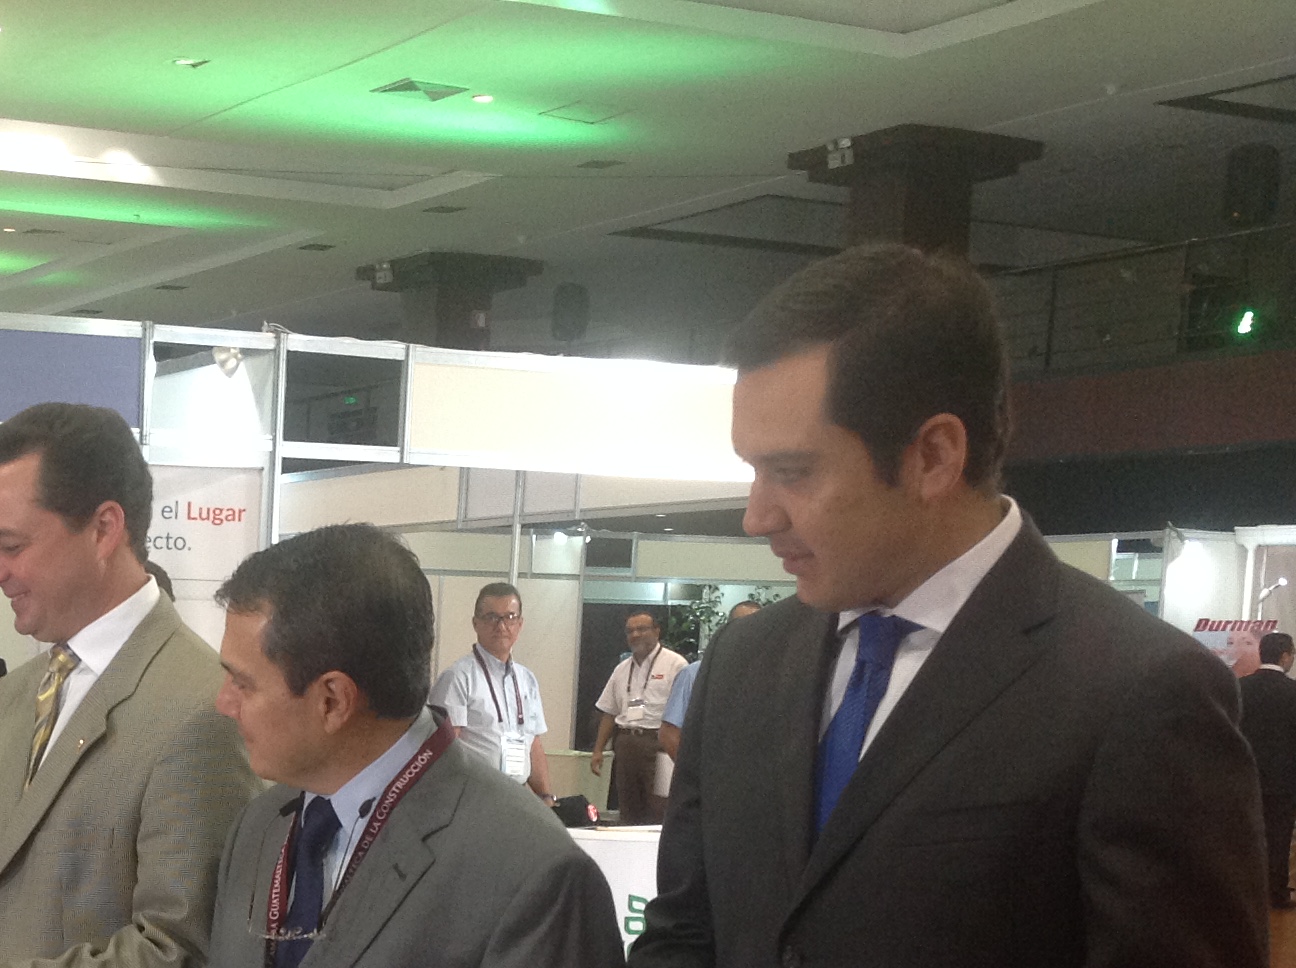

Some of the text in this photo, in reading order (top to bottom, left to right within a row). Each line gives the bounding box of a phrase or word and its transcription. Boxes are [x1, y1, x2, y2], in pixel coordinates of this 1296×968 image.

[161, 501, 246, 526] el Lugar
[1194, 617, 1279, 632] Durman
[375, 748, 434, 821] CONSTRUCCIÓN
[369, 821, 382, 834] LA
[361, 835, 375, 849] DE
